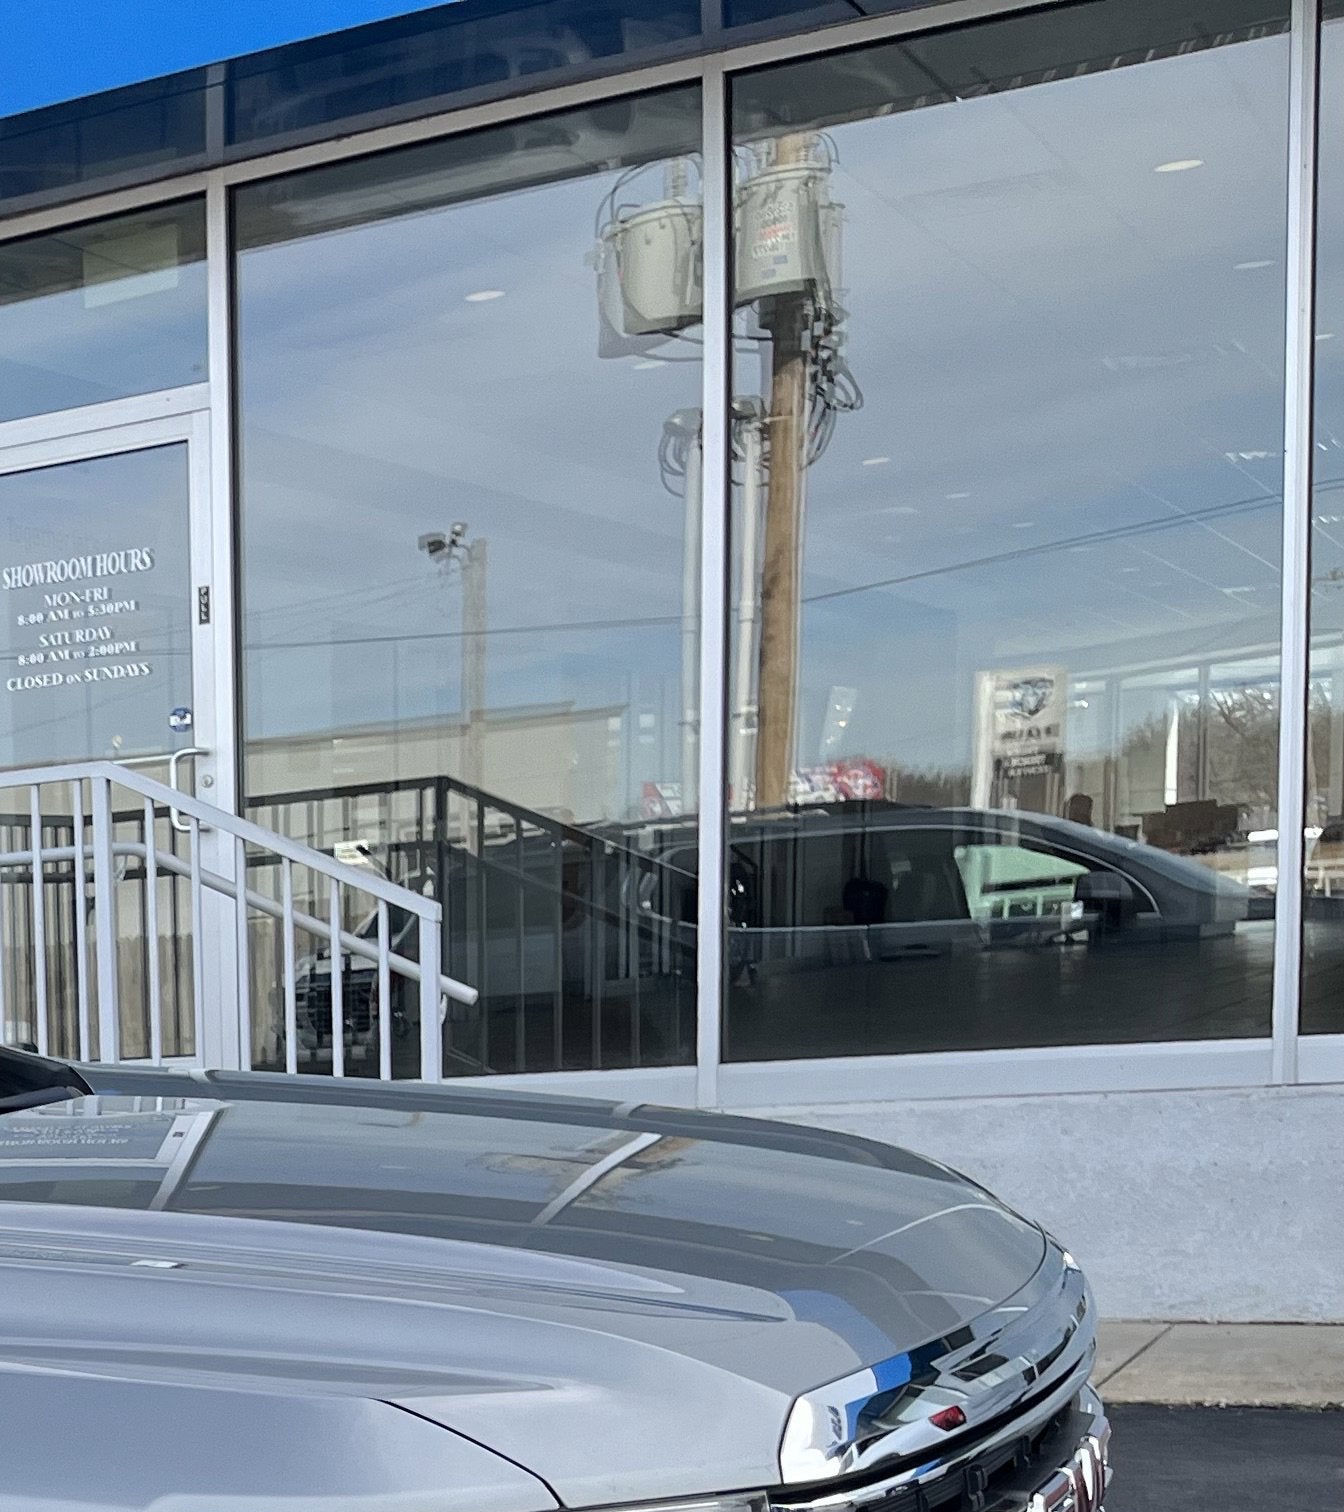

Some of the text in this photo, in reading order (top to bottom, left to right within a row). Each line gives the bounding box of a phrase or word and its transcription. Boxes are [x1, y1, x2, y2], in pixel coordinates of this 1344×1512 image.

[2, 547, 152, 590] SHOWROOM HOURS
[44, 586, 109, 608] MON-FRI
[17, 612, 44, 626] 8:00
[48, 608, 70, 622] AM
[39, 625, 113, 648] SATURDAY
[17, 652, 45, 666] 8:00
[47, 649, 70, 663] AM
[6, 672, 64, 692] CLOSED
[83, 661, 151, 683] SUNDAYS
